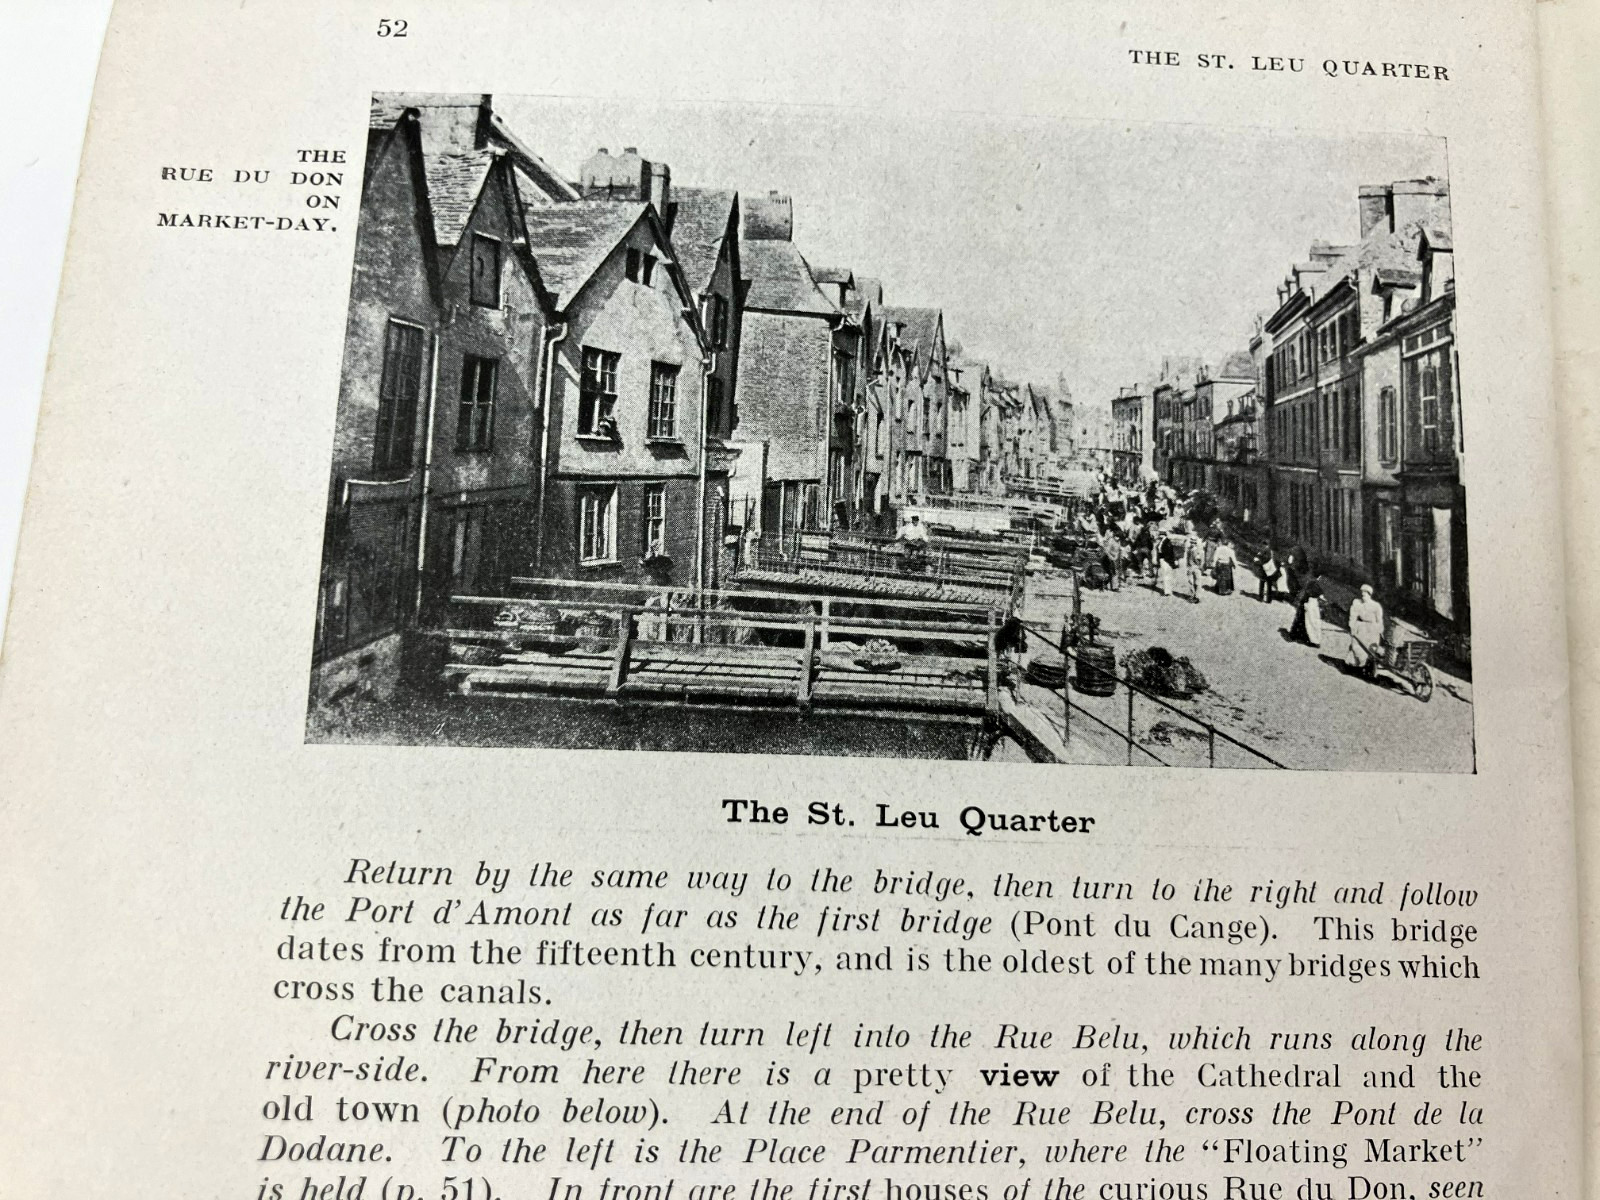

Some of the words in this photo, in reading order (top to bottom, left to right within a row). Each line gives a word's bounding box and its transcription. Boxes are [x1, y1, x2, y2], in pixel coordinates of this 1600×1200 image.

[377, 19, 408, 37] 52
[1129, 50, 1180, 66] THE
[1198, 54, 1233, 69] ST.
[1251, 56, 1304, 72] LEU
[1323, 60, 1449, 81] QUARTER
[297, 150, 346, 163] THE
[162, 167, 213, 182] RUE
[233, 170, 270, 183] DU
[290, 172, 343, 186] DON
[306, 195, 340, 209] ON
[157, 213, 336, 232] MARKET-DAY.
[722, 799, 788, 824] The
[808, 801, 854, 827] St.
[876, 804, 939, 828] Leu
[960, 806, 1095, 836] Quarter
[343, 859, 452, 885] Return
[475, 860, 510, 894] by
[530, 862, 573, 887] the
[591, 870, 668, 888] same
[688, 872, 748, 897] way
[767, 868, 791, 891] to
[811, 868, 852, 892] the
[874, 869, 973, 902] bridge,
[994, 873, 1053, 898] then
[1073, 876, 1133, 900] turn
[1152, 878, 1175, 901] to
[1250, 879, 1316, 909] right
[1334, 882, 1384, 904] and
[1400, 882, 1478, 911] follow
[281, 896, 325, 921] the
[345, 897, 414, 924] Port
[591, 909, 623, 926] as
[641, 903, 688, 934] far
[707, 910, 737, 928] as
[757, 905, 799, 930] the
[817, 906, 880, 937] first
[901, 908, 992, 941] bridge
[1011, 911, 1096, 942] (Pont
[1115, 914, 1151, 937] du
[1170, 914, 1277, 946] Cange).
[1313, 917, 1374, 940] This
[1391, 918, 1477, 949] bridge
[277, 935, 363, 961] dates
[378, 937, 456, 963] from
[470, 939, 521, 965] the
[536, 940, 676, 967] fifteenth
[690, 944, 821, 976] century,
[836, 946, 892, 970] and
[907, 947, 929, 971] is
[943, 947, 991, 972] the
[1003, 949, 1094, 975] oldest
[1107, 950, 1136, 974] of
[1145, 951, 1191, 975] the
[1200, 958, 1282, 983] many
[1288, 953, 1390, 983] bridges
[1398, 955, 1480, 979] which
[274, 980, 354, 1001] cross
[371, 976, 423, 1002] the
[441, 979, 551, 1005] canals.
[331, 1014, 417, 1042] Cross
[434, 1017, 478, 1043] the
[496, 1018, 601, 1051] bridge,
[619, 1019, 683, 1045] then
[700, 1021, 764, 1046] turn
[786, 1021, 832, 1055] left
[854, 1023, 910, 1048] into
[931, 1024, 971, 1048] the
[994, 1024, 1052, 1049] Rue
[1072, 1025, 1147, 1055] Belu,
[1169, 1025, 1250, 1050] which
[1270, 1033, 1332, 1050] runs
[1351, 1026, 1426, 1057] along
[1446, 1028, 1482, 1051] the
[265, 1054, 427, 1082] river-side.
[470, 1057, 558, 1083] From
[582, 1059, 645, 1084] here
[669, 1060, 741, 1085] there
[766, 1061, 790, 1086] is
[814, 1068, 831, 1086] a
[853, 1063, 953, 1094] pretty
[980, 1063, 1060, 1087] view
[1082, 1063, 1111, 1086] of
[1127, 1063, 1174, 1087] the
[1198, 1063, 1341, 1087] Cathedral
[1363, 1064, 1415, 1088] and
[1437, 1065, 1481, 1088] the
[263, 1095, 313, 1121] old
[336, 1097, 419, 1122] town
[443, 1096, 540, 1130] (photo
[563, 1097, 668, 1131] below).
[710, 1099, 748, 1124] At
[769, 1100, 810, 1125] the
[831, 1101, 884, 1125] end
[902, 1100, 931, 1132] of
[950, 1101, 991, 1125] the
[1012, 1101, 1070, 1126] Rue
[1090, 1100, 1165, 1130] Belu,
[1186, 1107, 1253, 1125] cross
[1272, 1101, 1311, 1125] the
[1330, 1101, 1396, 1125] Pont
[1414, 1102, 1442, 1125] de
[1460, 1101, 1483, 1124] la
[257, 1135, 391, 1163] Dodane.
[442, 1136, 482, 1162] To
[502, 1138, 546, 1163] the
[566, 1137, 614, 1170] left
[635, 1138, 659, 1163] is
[679, 1138, 722, 1163] the
[742, 1138, 825, 1164] Place
[845, 1139, 1025, 1169] Parmentier,
[1045, 1139, 1127, 1163] where
[1145, 1138, 1184, 1162] the
[258, 1177, 283, 1200] is
[300, 1176, 367, 1200] held
[548, 1177, 582, 1200] In
[600, 1177, 674, 1200] front
[689, 1185, 736, 1200] are
[751, 1178, 793, 1200] the
[809, 1178, 871, 1200] first
[885, 1178, 988, 1200] houses
[1004, 1178, 1031, 1200] of
[1045, 1177, 1085, 1200] the
[1099, 1178, 1207, 1200] curious
[1223, 1176, 1282, 1200] Rue
[1297, 1178, 1335, 1200] du
[1429, 1181, 1484, 1199] seen
